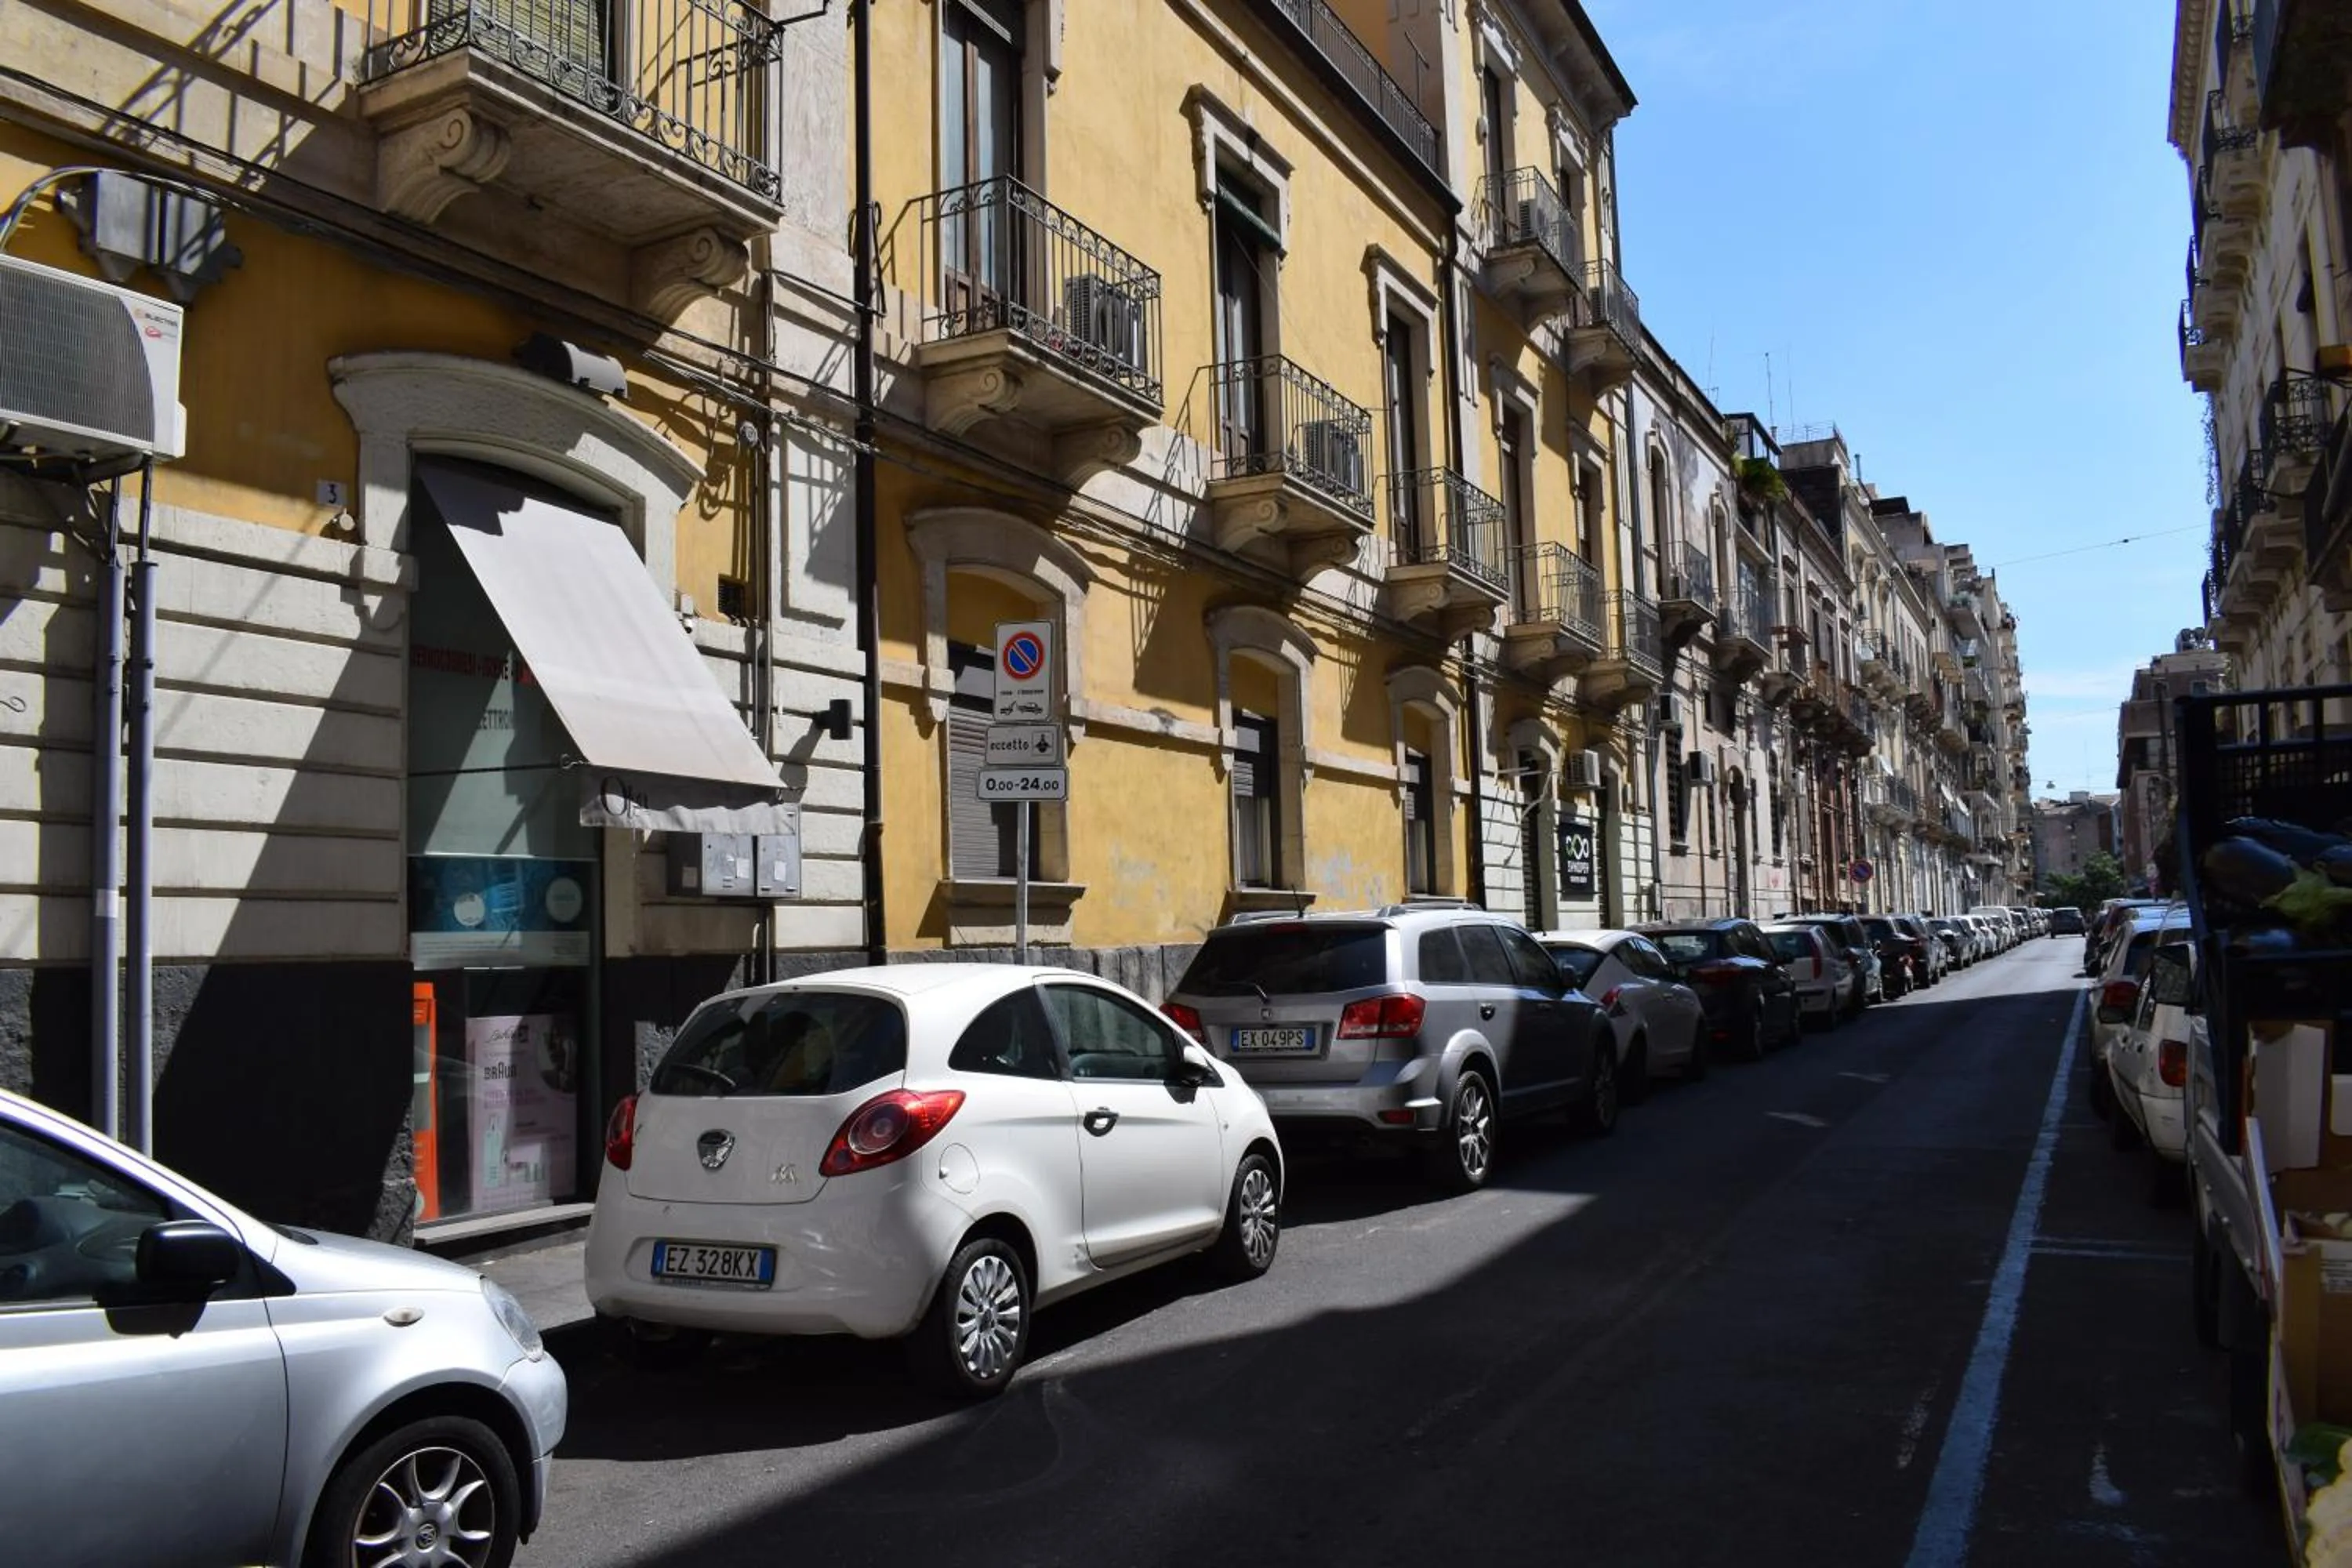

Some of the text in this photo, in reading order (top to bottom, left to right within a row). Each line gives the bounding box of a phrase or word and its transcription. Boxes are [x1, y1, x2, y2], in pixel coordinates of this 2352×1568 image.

[328, 484, 337, 503] 3
[990, 738, 1029, 750] eccetto
[1241, 1028, 1304, 1047] EX 049PS
[666, 1247, 759, 1277] EZ 328KX
